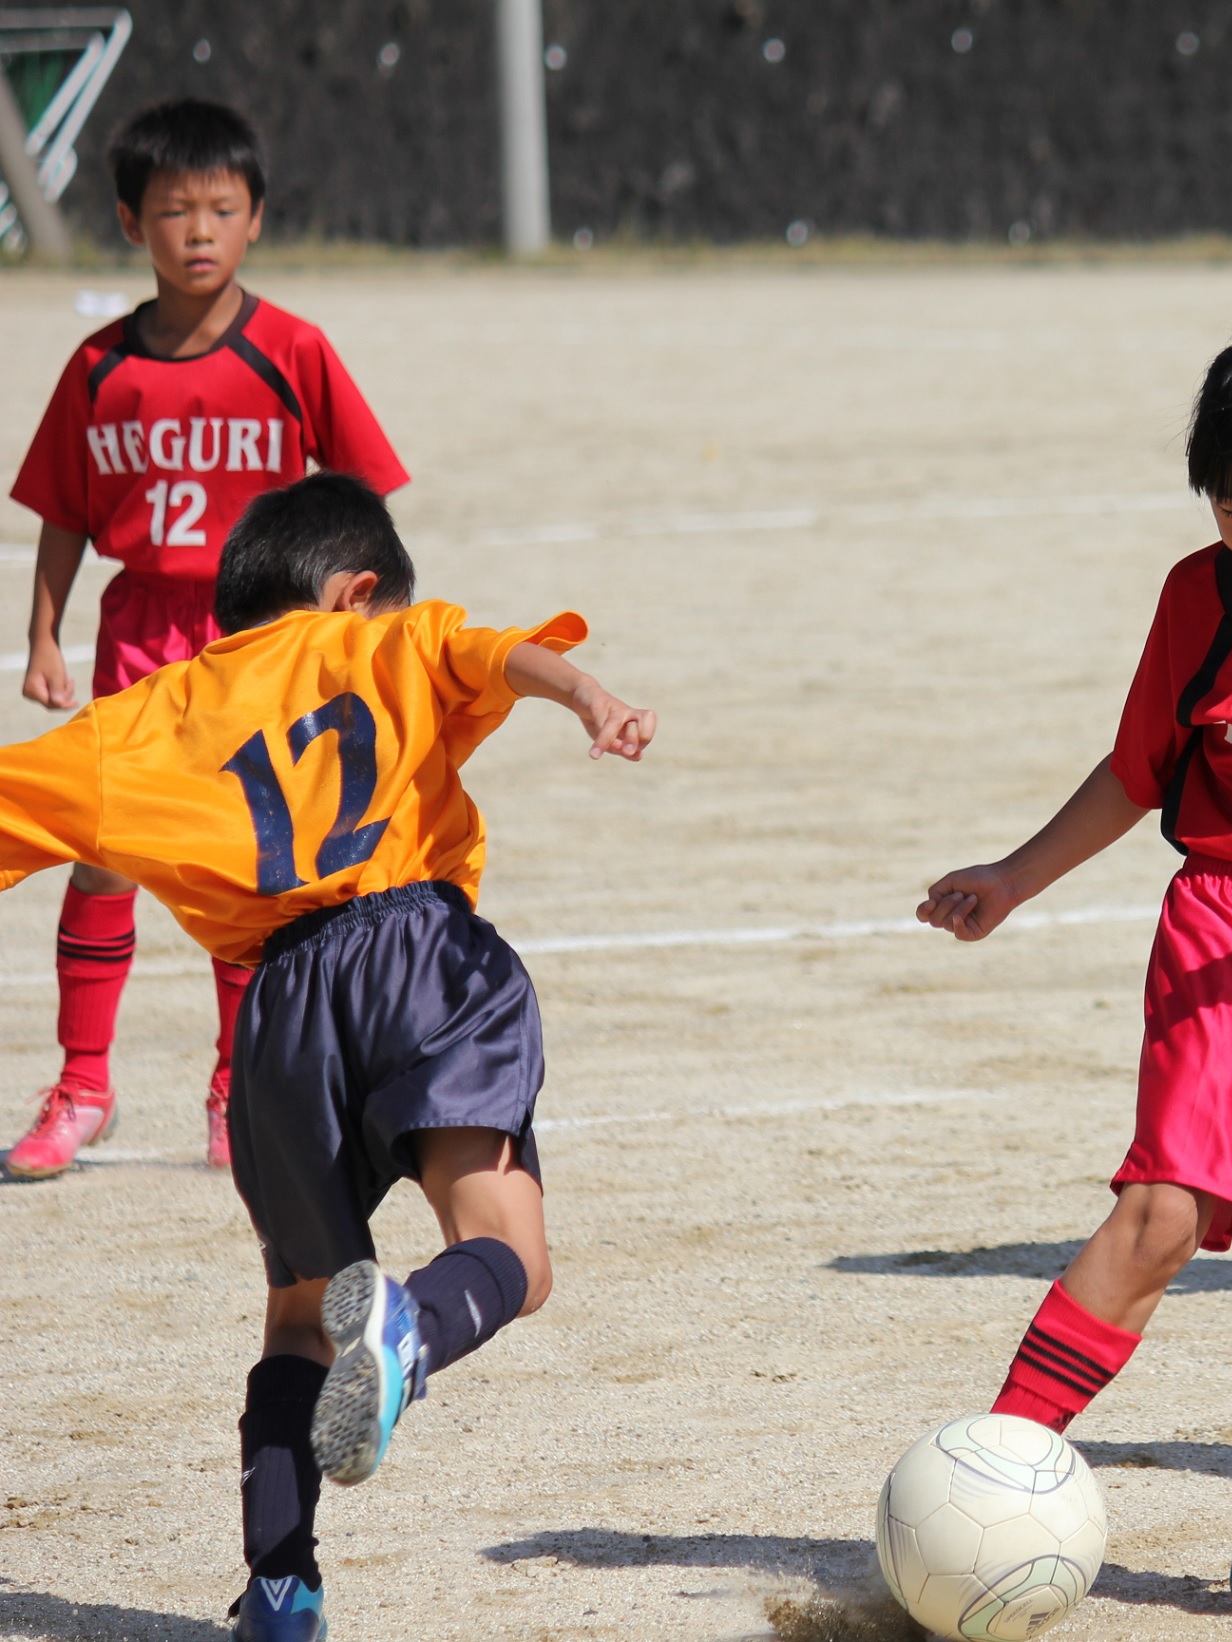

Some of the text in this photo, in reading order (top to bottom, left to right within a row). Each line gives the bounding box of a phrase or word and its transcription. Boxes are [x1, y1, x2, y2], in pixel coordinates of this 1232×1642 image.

[87, 416, 283, 475] HEGURI
[145, 479, 208, 547] 12
[218, 691, 392, 896] 12
